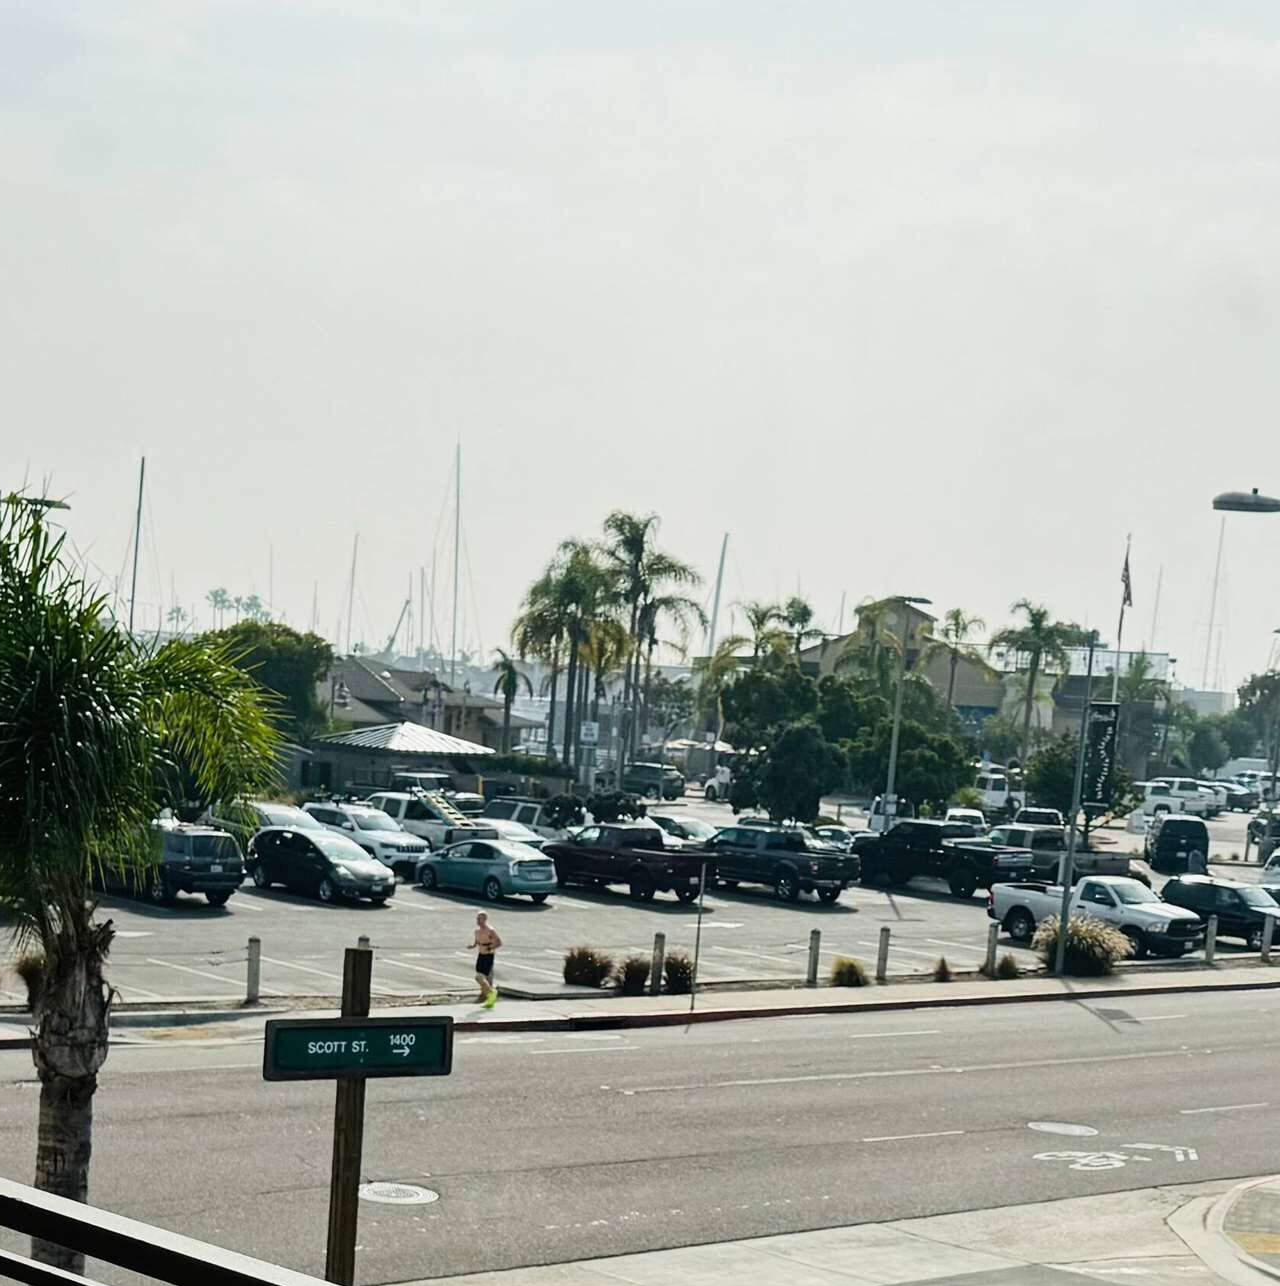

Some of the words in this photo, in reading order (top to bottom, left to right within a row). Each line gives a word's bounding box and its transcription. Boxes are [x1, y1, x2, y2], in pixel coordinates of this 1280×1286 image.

[389, 1033, 416, 1046] 1400
[307, 1041, 347, 1054] SCOTT
[352, 1041, 369, 1053] ST.
